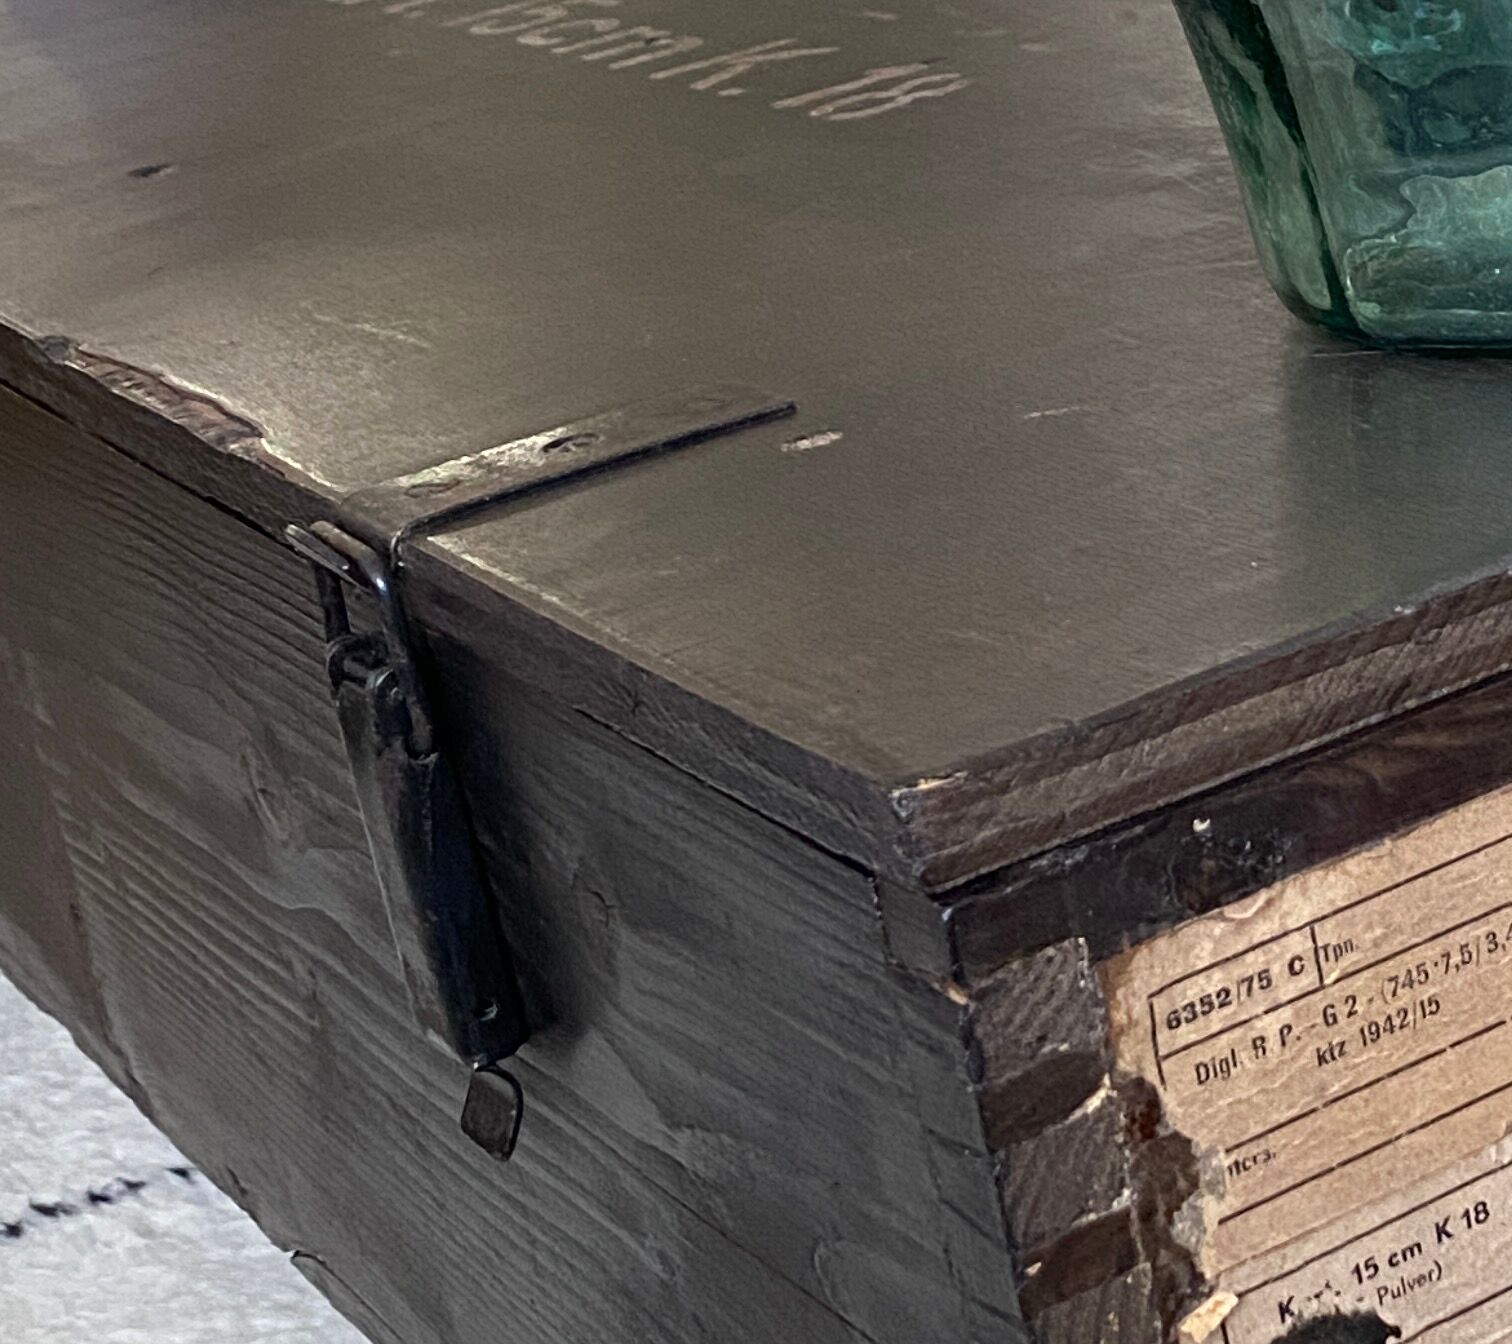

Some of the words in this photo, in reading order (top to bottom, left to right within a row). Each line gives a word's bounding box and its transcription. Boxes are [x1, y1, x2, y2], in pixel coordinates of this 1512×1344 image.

[770, 62, 972, 122] 18
[1165, 968, 1273, 1031] 6352/75
[1287, 954, 1306, 977] C
[1322, 1003, 1338, 1028] G
[1343, 993, 1359, 1019] 2
[1358, 996, 1441, 1048] 1942/15
[1350, 1256, 1380, 1286] 15
[1387, 1242, 1423, 1268] cm
[1434, 1215, 1454, 1245] K
[1460, 1201, 1491, 1230] 18
